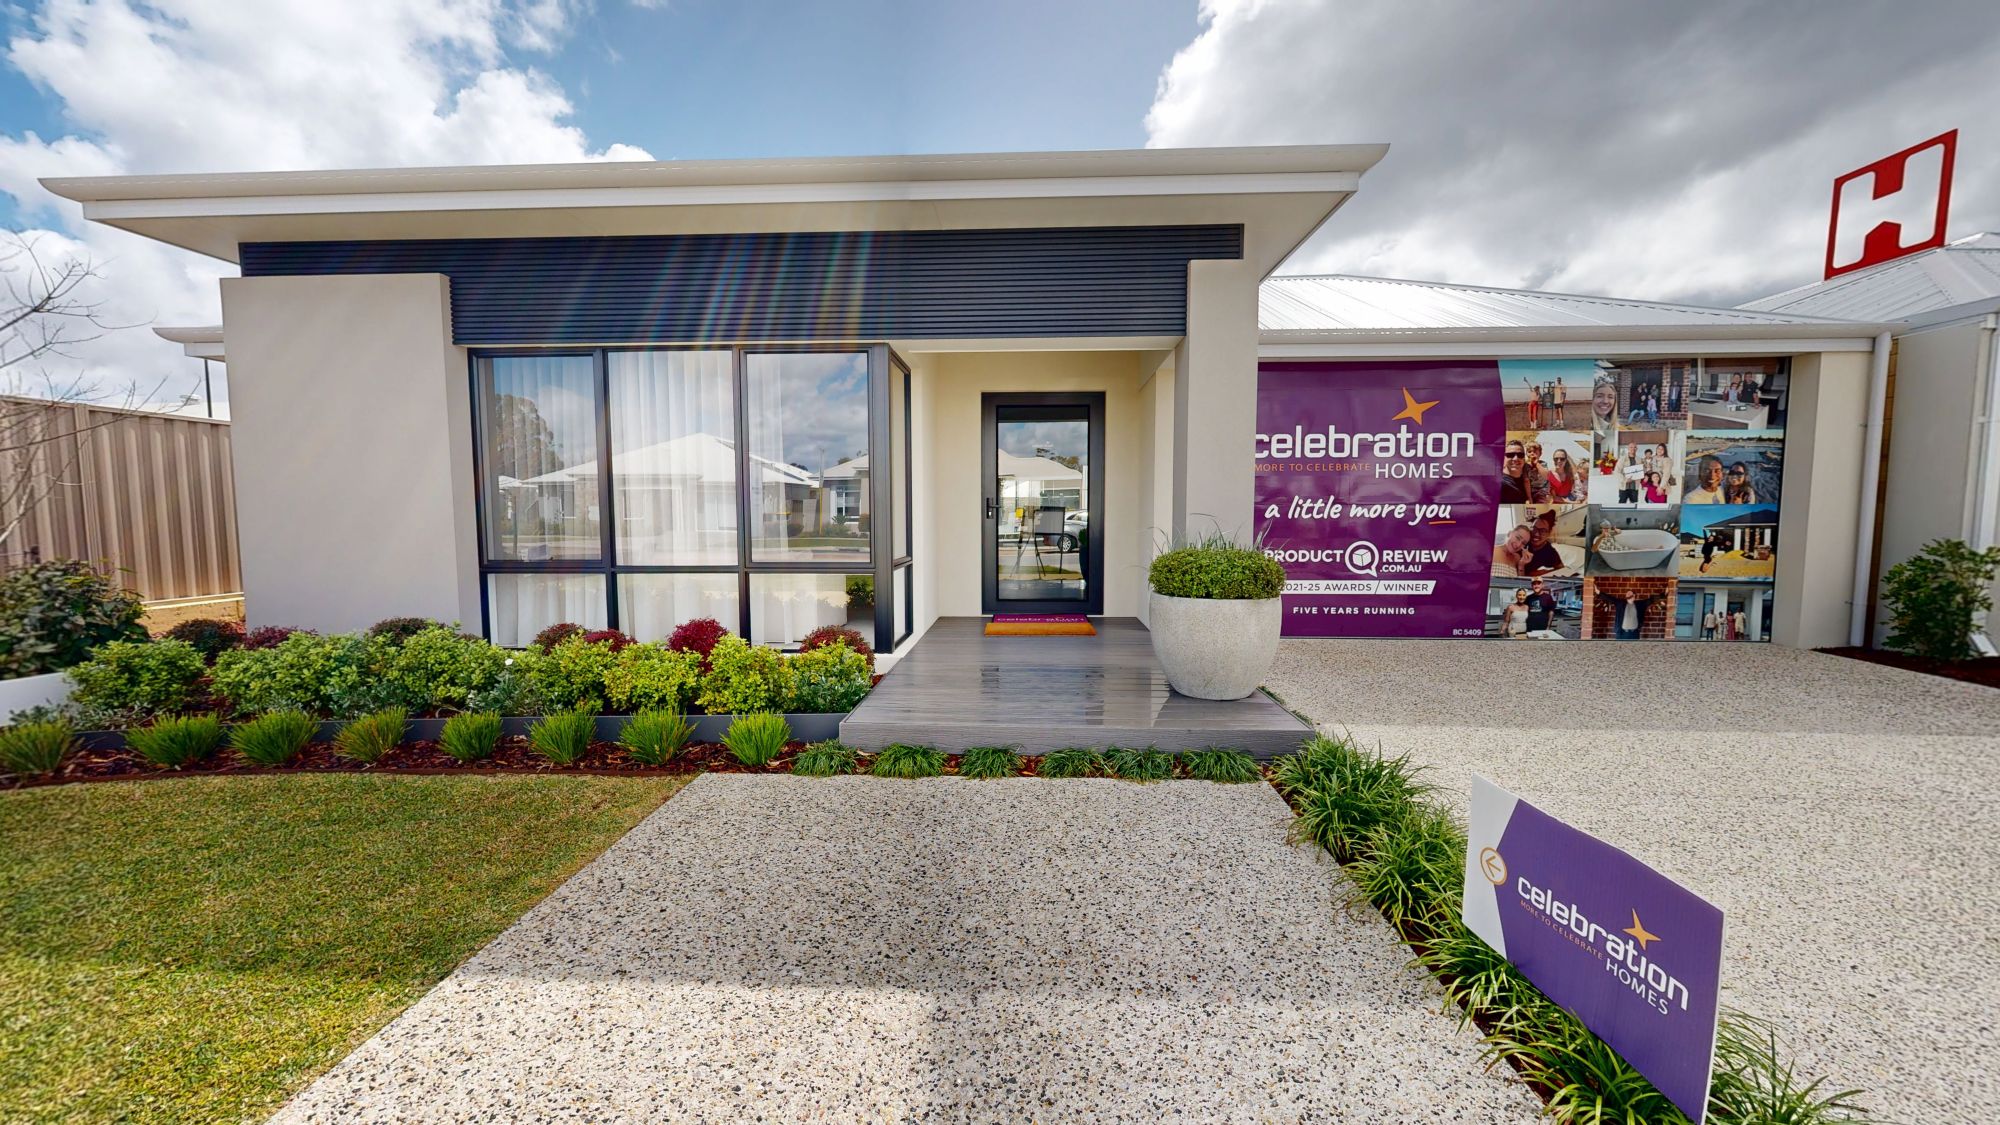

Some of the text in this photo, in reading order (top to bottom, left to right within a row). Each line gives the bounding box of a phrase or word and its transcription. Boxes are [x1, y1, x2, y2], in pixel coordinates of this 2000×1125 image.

[1255, 424, 1474, 459] celebration
[1255, 462, 1371, 472] MORE TO CELEBRATE
[1375, 462, 1454, 479] HOMES
[1264, 495, 1452, 526] a little more you
[1264, 550, 1448, 563] PRODUCT REVIEW
[1379, 564, 1422, 573] .COM.AU
[1324, 583, 1372, 592] AWARDS
[1383, 583, 1429, 592] WINNER
[1293, 606, 1415, 615] FIVE YEARS RUNNING
[1520, 899, 1604, 960] MORE TO CELEBRATE
[1517, 876, 1689, 1011] celebration
[1605, 957, 1669, 1016] HOMES
